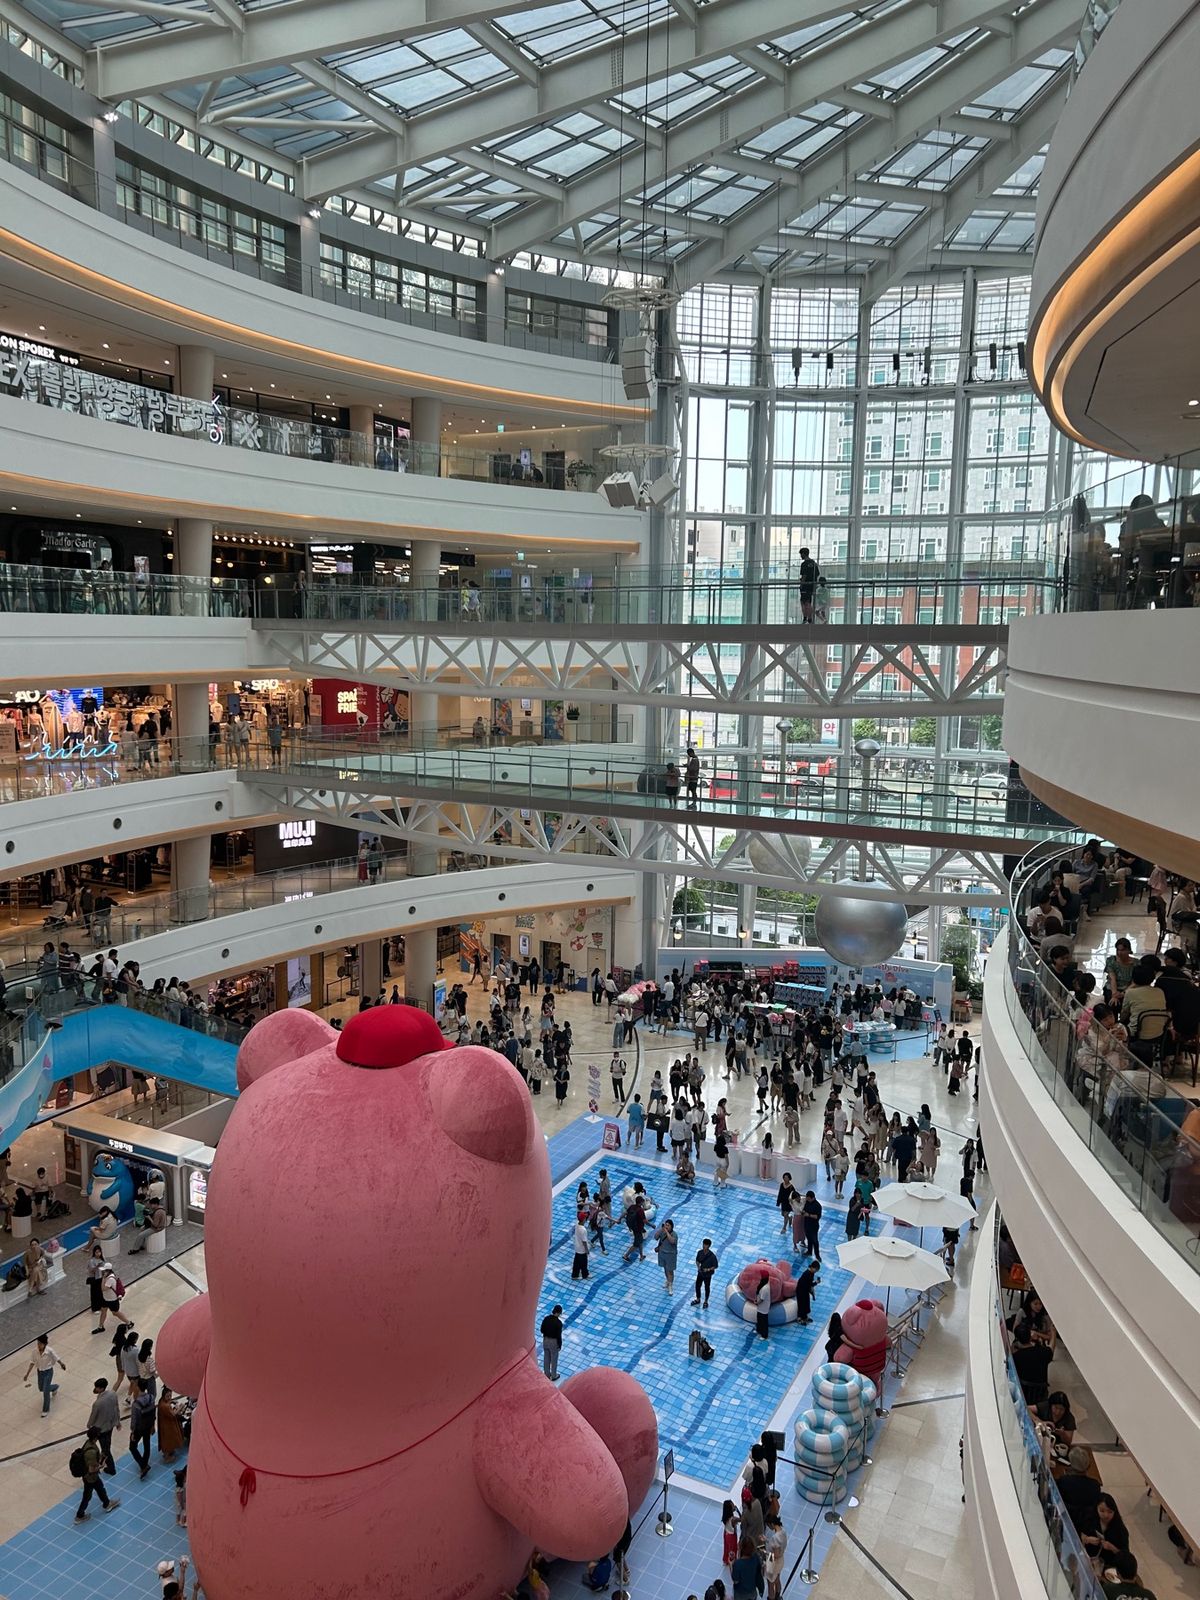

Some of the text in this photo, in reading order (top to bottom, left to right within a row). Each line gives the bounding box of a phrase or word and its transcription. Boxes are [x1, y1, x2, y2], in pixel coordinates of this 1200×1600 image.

[19, 340, 56, 360] SPOREX
[44, 535, 97, 549] Mad for Garlic
[279, 820, 316, 839] MUJI
